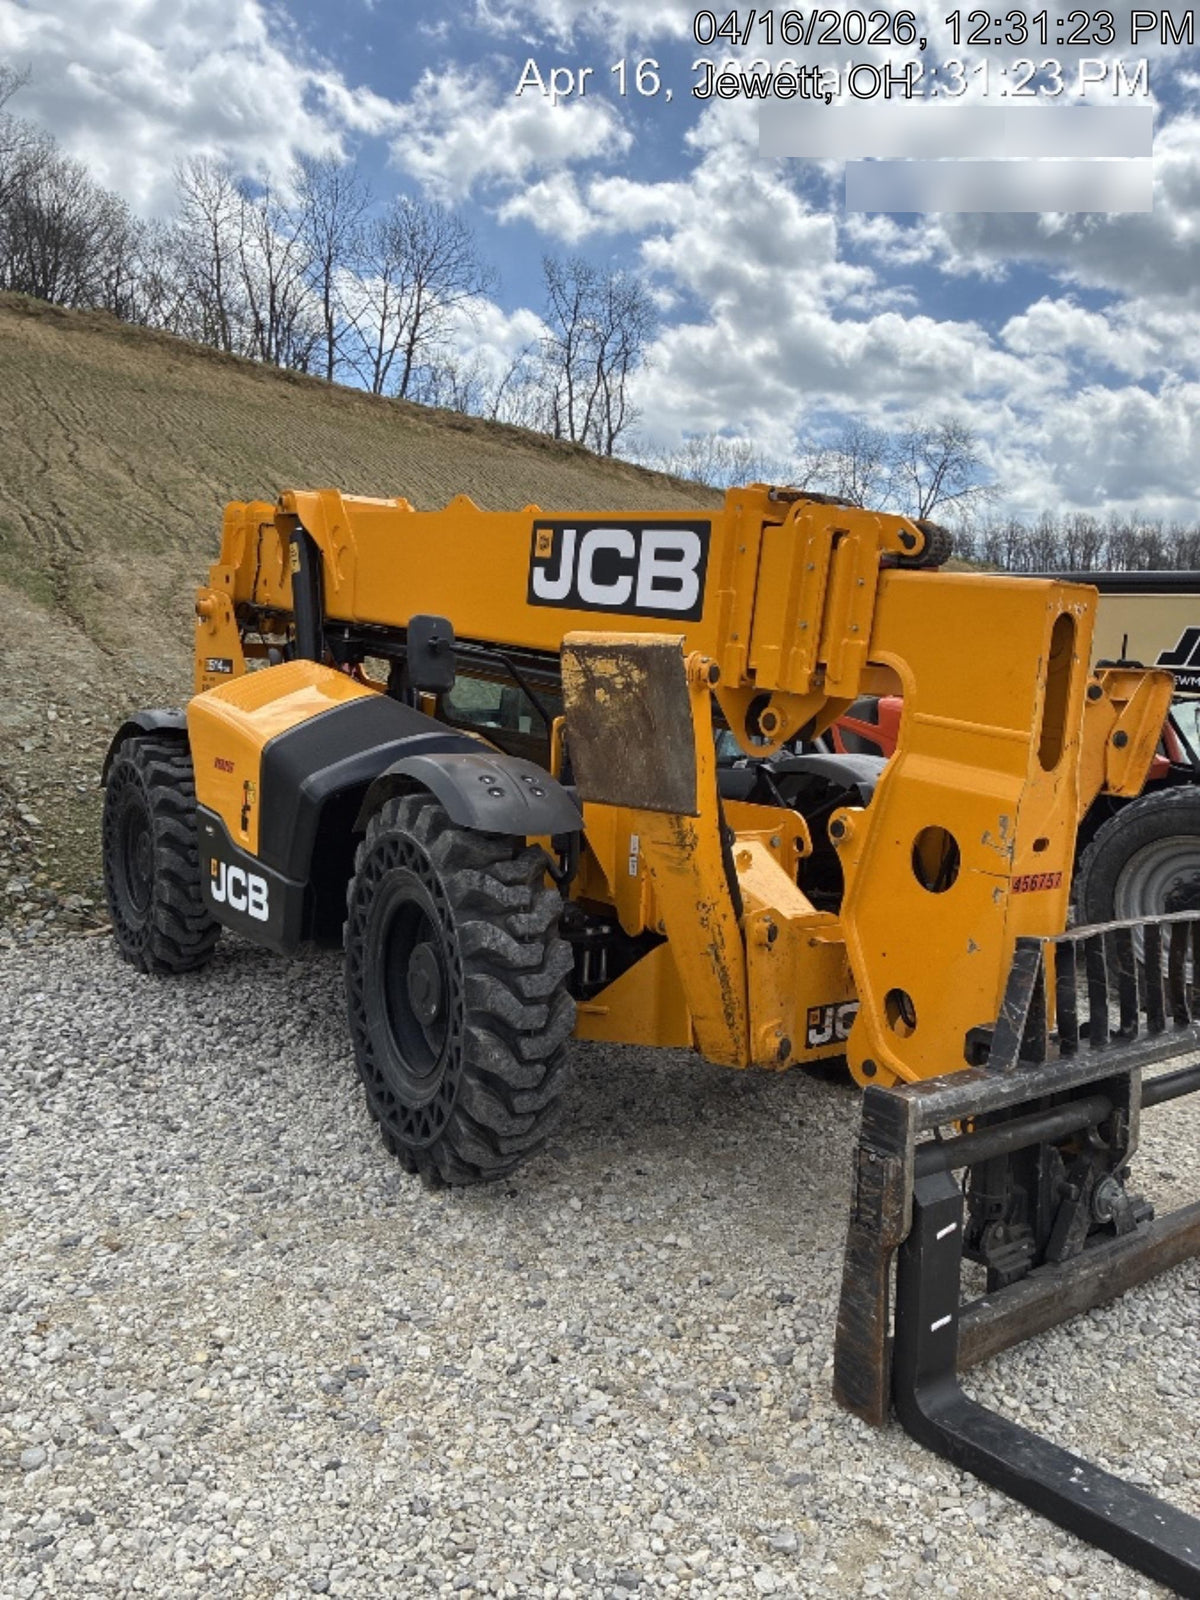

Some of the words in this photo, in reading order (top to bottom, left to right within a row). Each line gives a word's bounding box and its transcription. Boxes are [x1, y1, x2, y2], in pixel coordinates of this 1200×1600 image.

[533, 529, 701, 610] JCB
[211, 861, 269, 921] JCB
[808, 1002, 860, 1045] JC
